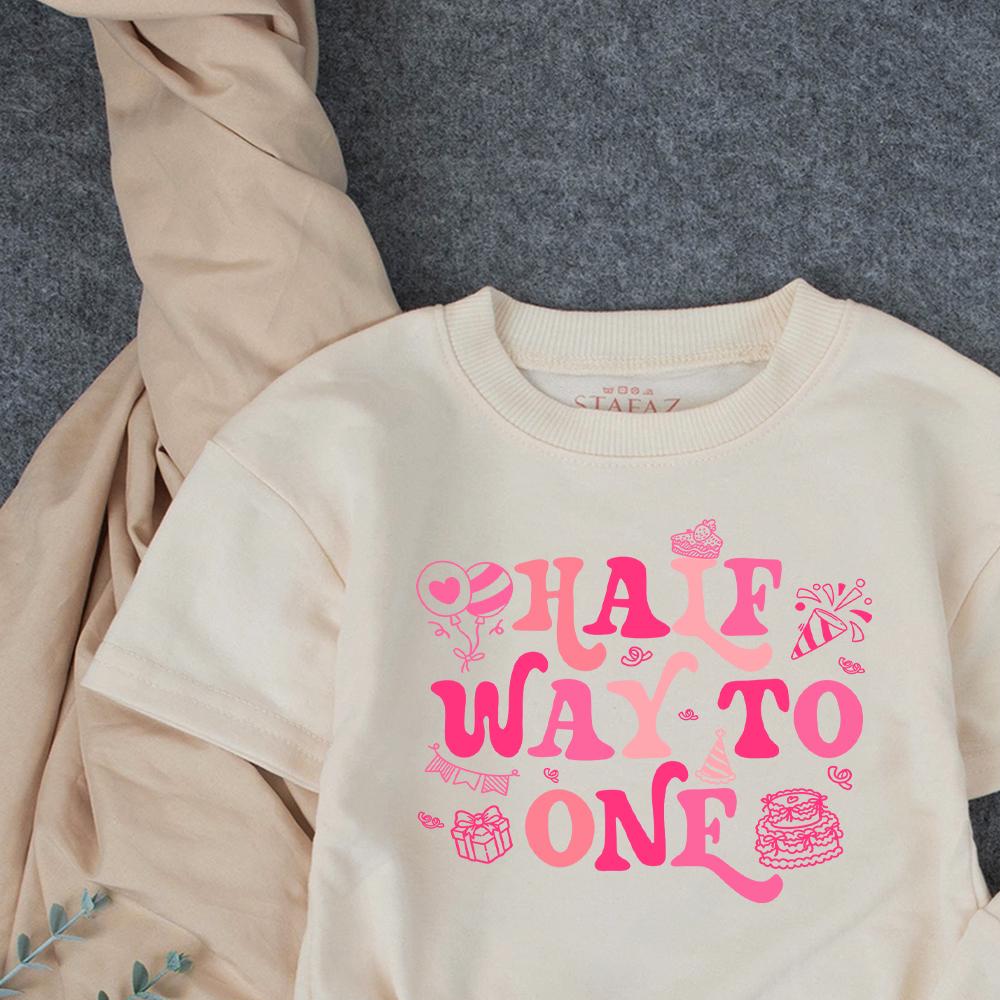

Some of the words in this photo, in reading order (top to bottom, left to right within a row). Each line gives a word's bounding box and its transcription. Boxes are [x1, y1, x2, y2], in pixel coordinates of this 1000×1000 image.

[512, 556, 782, 672] HALF
[431, 651, 698, 761] WAY
[716, 678, 864, 760] TO
[525, 760, 784, 904] ONE
